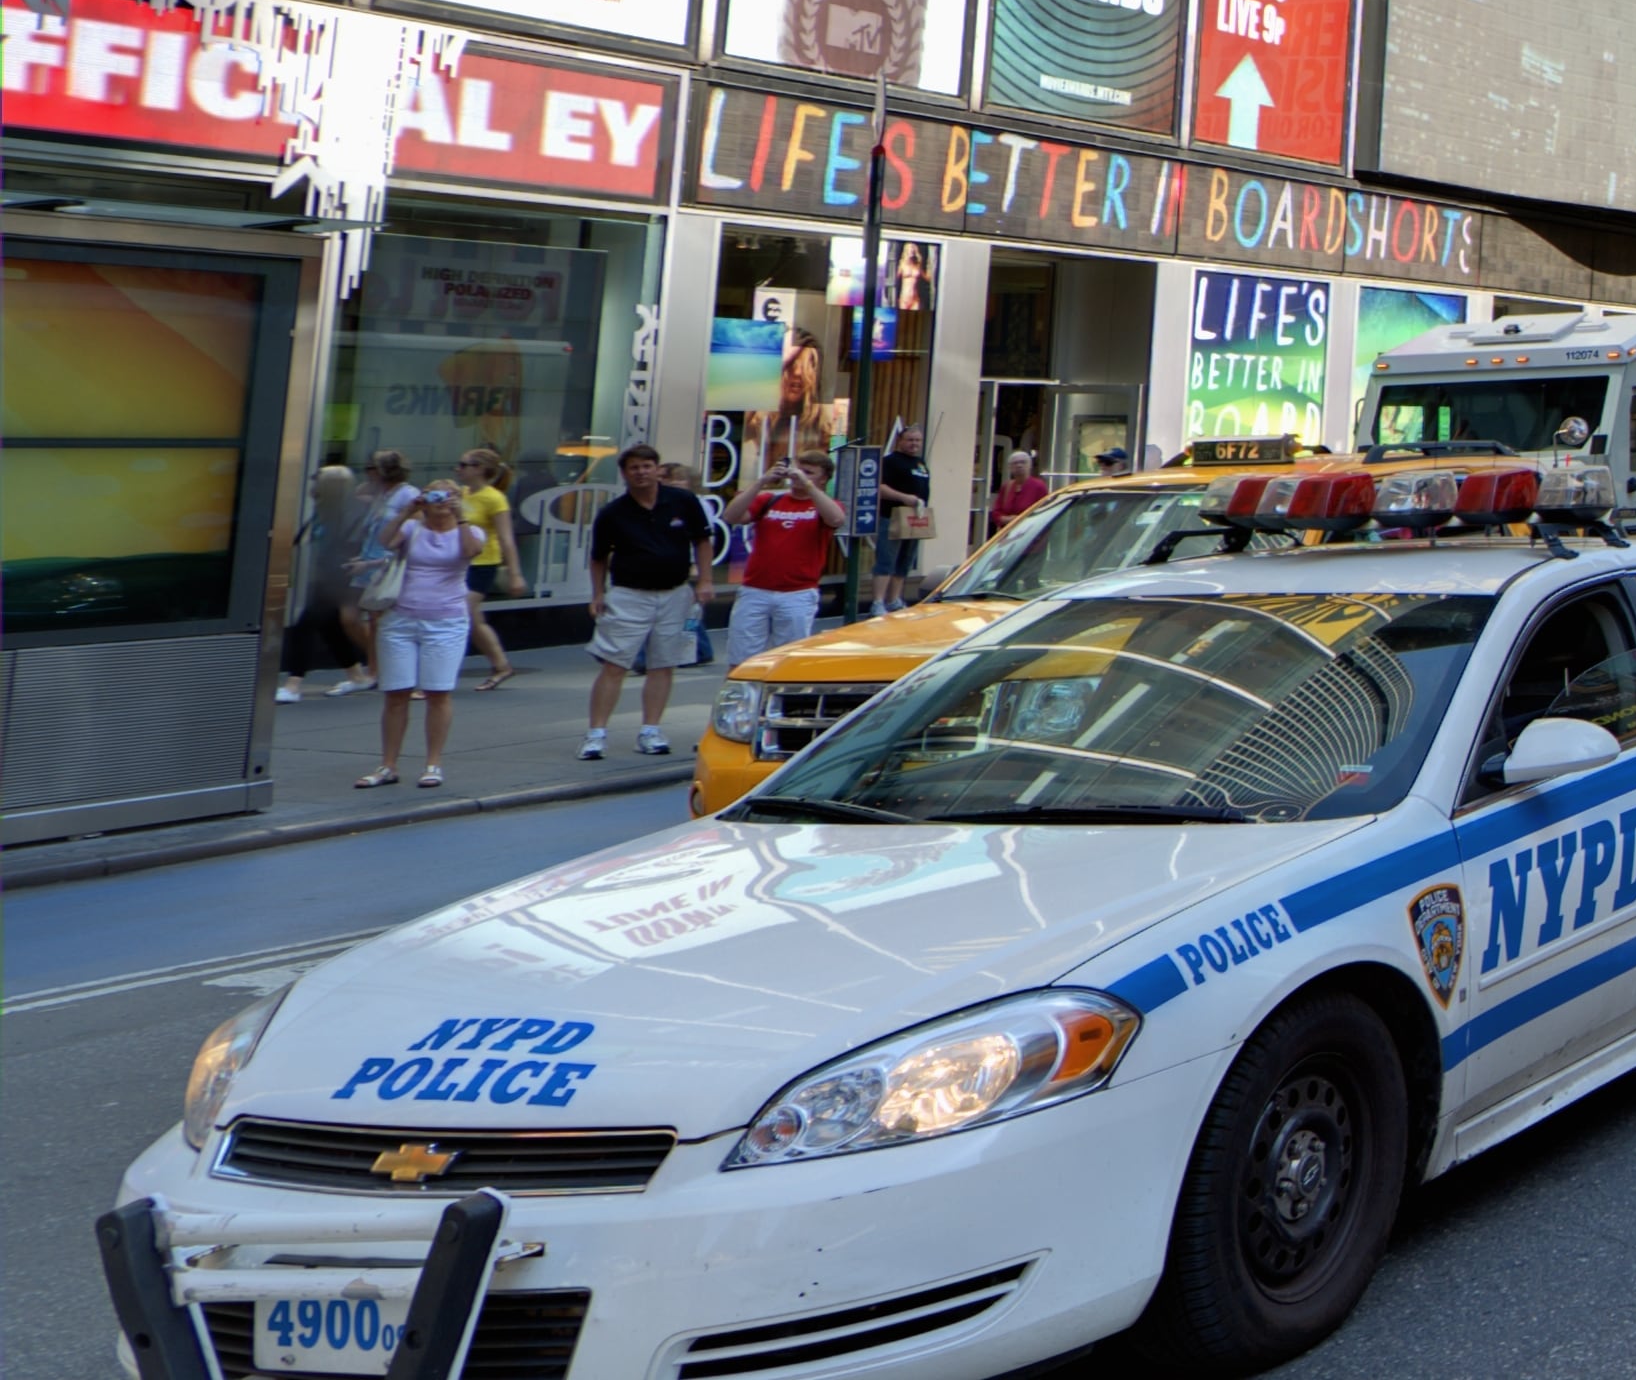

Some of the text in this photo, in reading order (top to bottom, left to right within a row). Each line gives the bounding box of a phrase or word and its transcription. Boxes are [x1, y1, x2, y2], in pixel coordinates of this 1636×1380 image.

[826, 4, 884, 56] MTV
[539, 87, 663, 168] EY
[942, 127, 1131, 230] BETTER
[1151, 144, 1187, 236] IN
[1194, 277, 1326, 346] LIFE'S
[1190, 351, 1322, 394] BETTER IN
[1565, 349, 1600, 361] 112074
[1215, 442, 1259, 460] 6F72
[1177, 901, 1292, 985] POLICE
[410, 1017, 596, 1056] NYPD
[333, 1057, 596, 1108] POLICE
[267, 1299, 380, 1352] 4900
